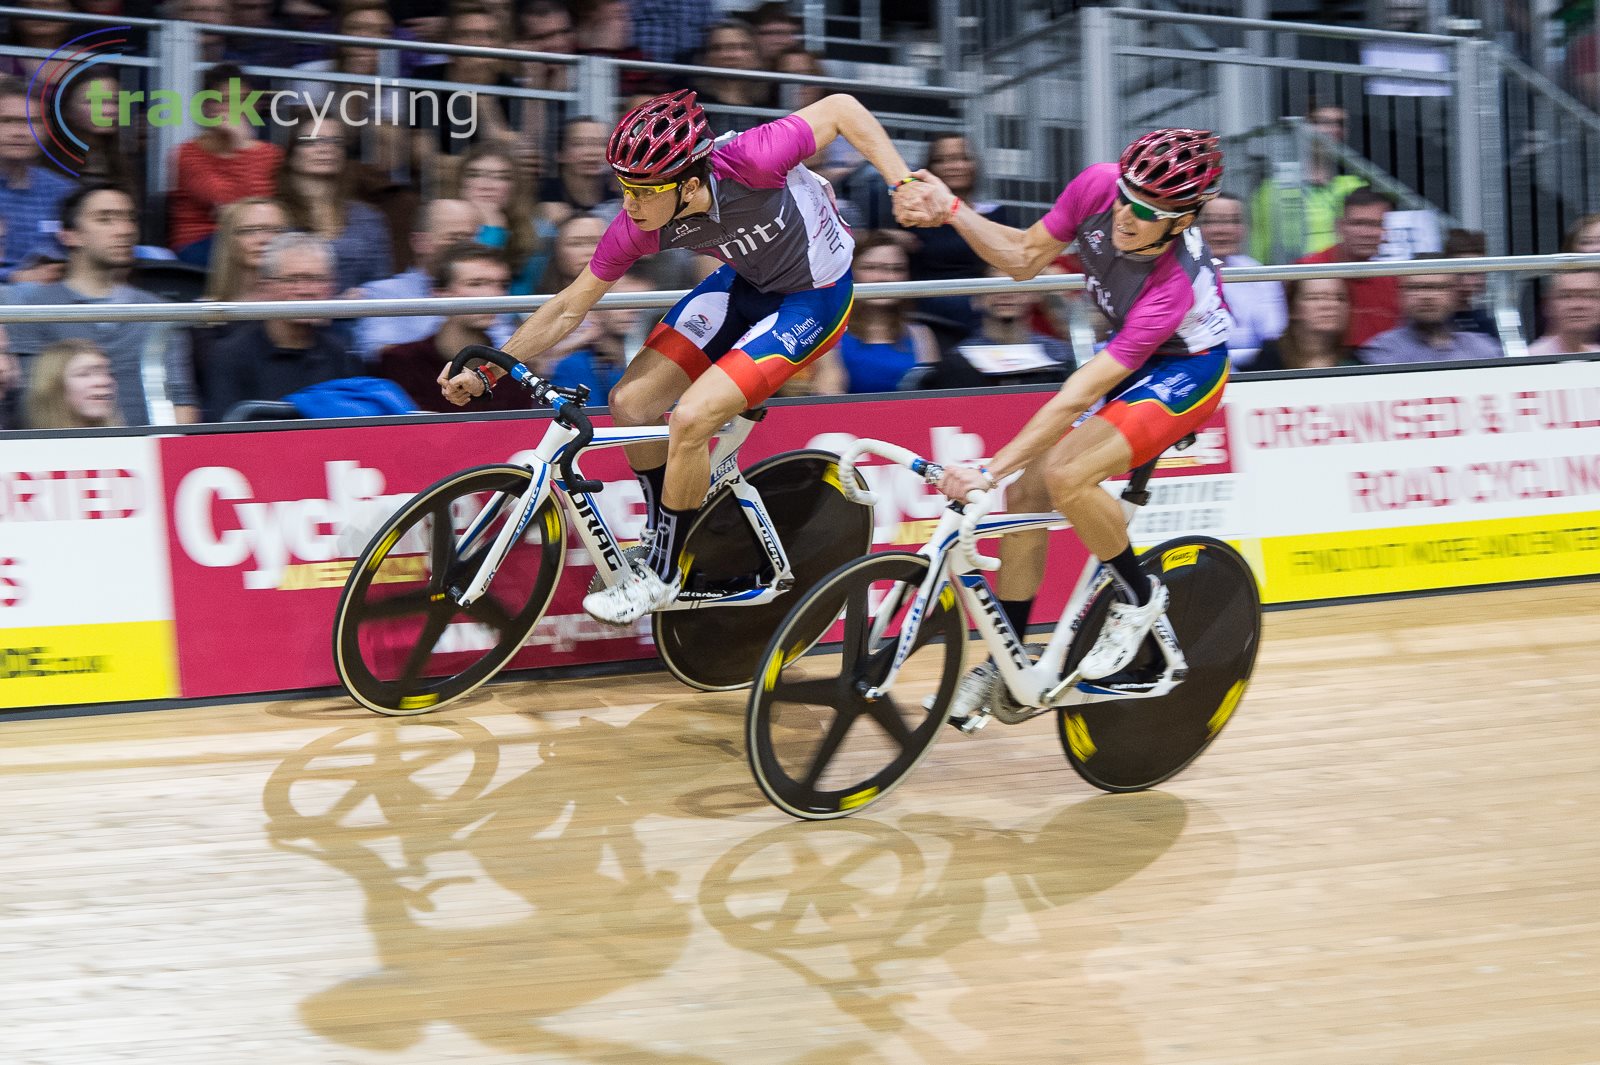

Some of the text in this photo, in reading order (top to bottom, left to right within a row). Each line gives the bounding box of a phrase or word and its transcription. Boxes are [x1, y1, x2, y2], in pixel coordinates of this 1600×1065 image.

[792, 316, 817, 337] Liberty
[1347, 465, 1454, 514] ROAD
[566, 489, 624, 572] DRAG
